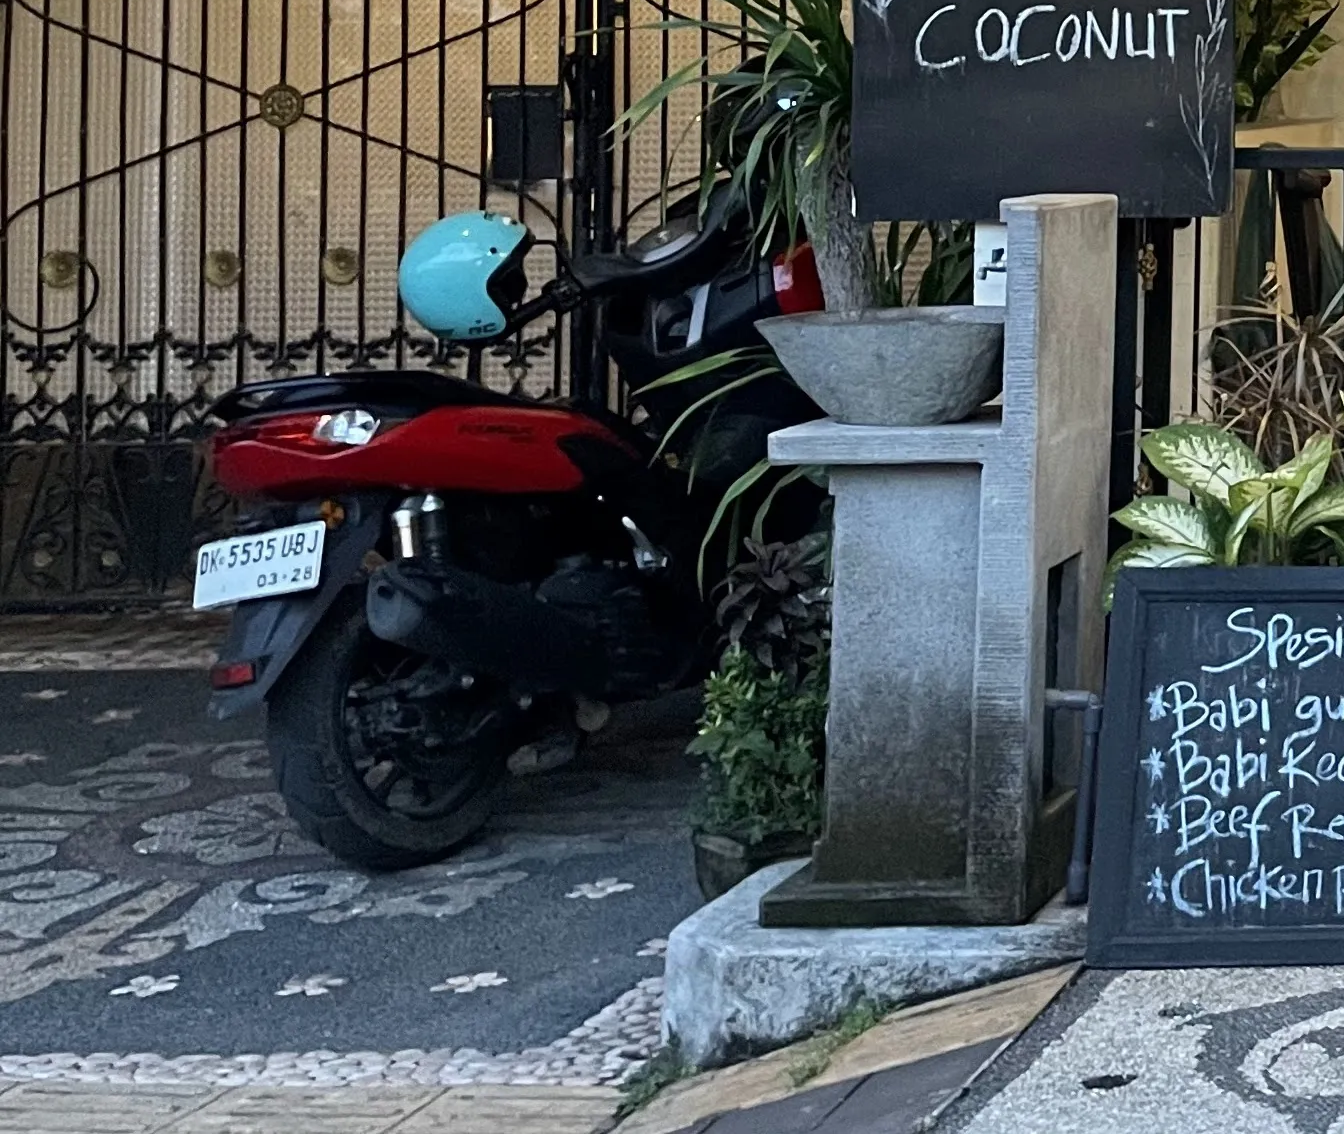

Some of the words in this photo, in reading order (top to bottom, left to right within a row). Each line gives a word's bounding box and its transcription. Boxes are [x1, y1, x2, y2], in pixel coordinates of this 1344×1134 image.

[915, 4, 1190, 68] COCONUT
[228, 537, 277, 568] 5535
[1165, 677, 1272, 740] Babi
[1169, 737, 1269, 797] Babi
[1170, 791, 1282, 869] Beef
[1170, 858, 1323, 917] Chicken
